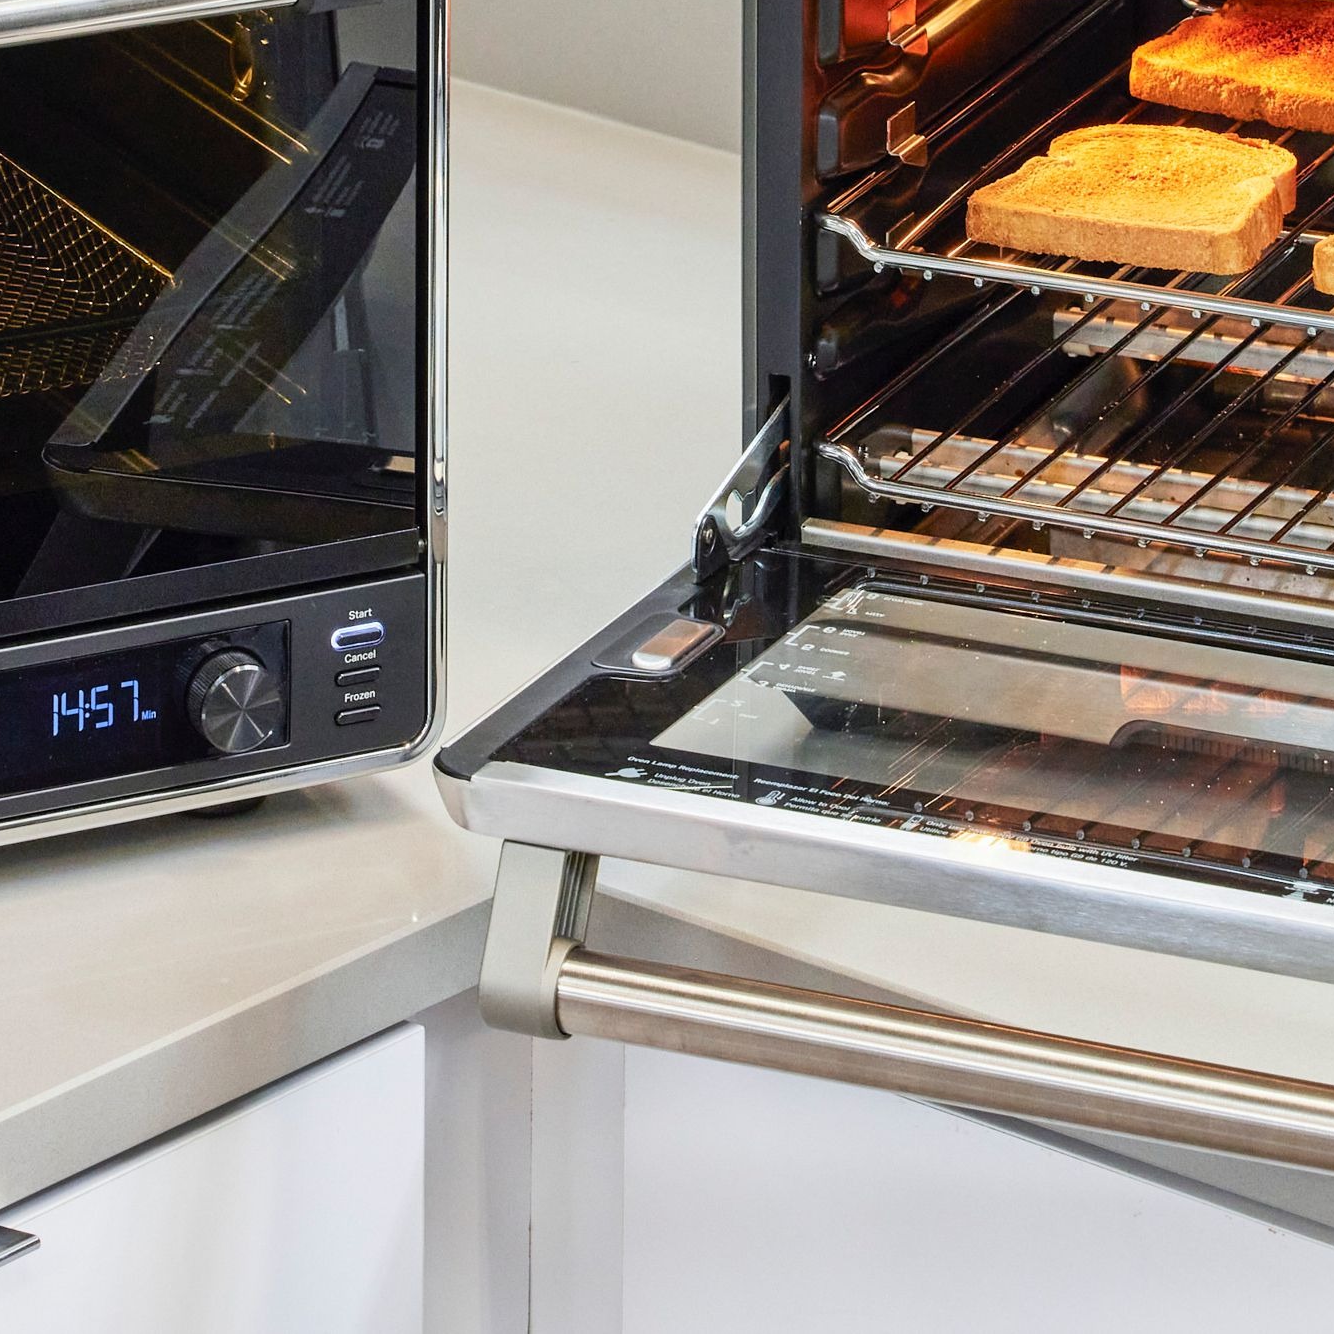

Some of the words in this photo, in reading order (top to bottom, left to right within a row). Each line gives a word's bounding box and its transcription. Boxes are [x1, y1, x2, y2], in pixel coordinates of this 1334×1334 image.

[348, 608, 373, 620] Start
[344, 649, 377, 664] Cancel
[344, 690, 376, 703] Frozen
[53, 680, 139, 736] 14:57
[141, 709, 157, 721] Min
[627, 756, 650, 764] Oven
[651, 760, 677, 769] Lamp
[654, 772, 687, 783] Unplug
[753, 778, 808, 792] Reemplazar
[790, 796, 817, 805] Allow
[783, 802, 820, 815] Permita
